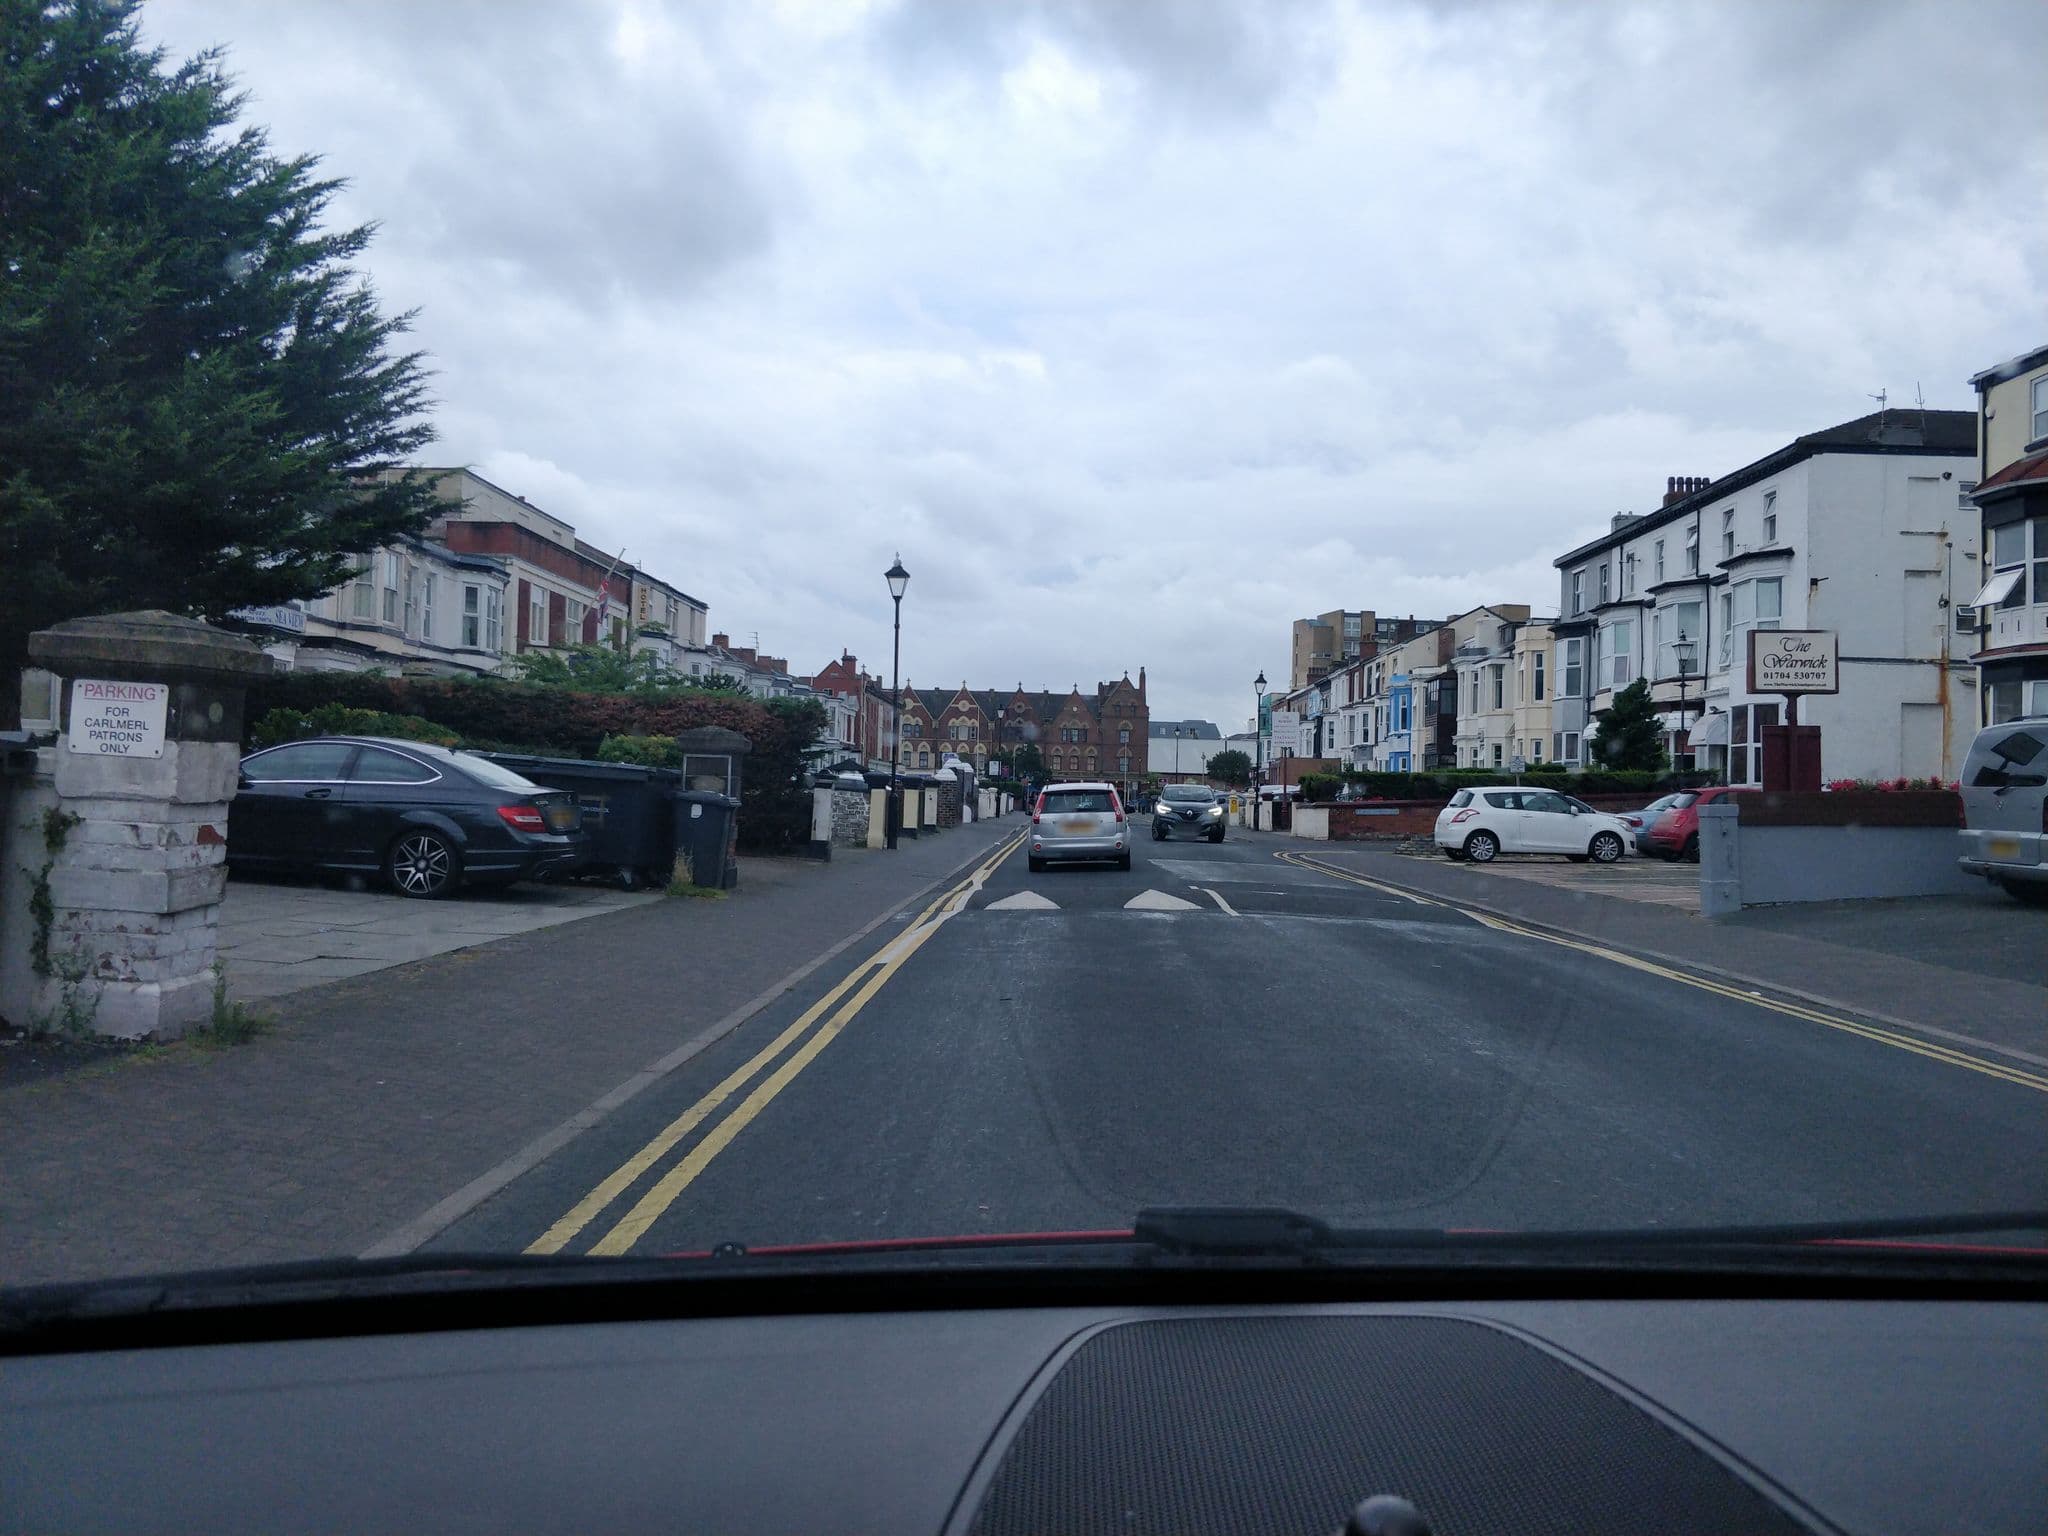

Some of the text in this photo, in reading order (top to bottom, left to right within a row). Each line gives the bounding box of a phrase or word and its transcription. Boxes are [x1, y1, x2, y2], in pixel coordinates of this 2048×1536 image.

[1779, 637, 1812, 653] The
[1763, 653, 1828, 669] Warwick
[1763, 672, 1826, 680] 01704 530707
[84, 683, 156, 701] PARKING
[105, 706, 130, 717] FOR
[84, 718, 150, 731] CARLMERL
[89, 730, 143, 743] PATRONS
[99, 743, 130, 754] ONLY
